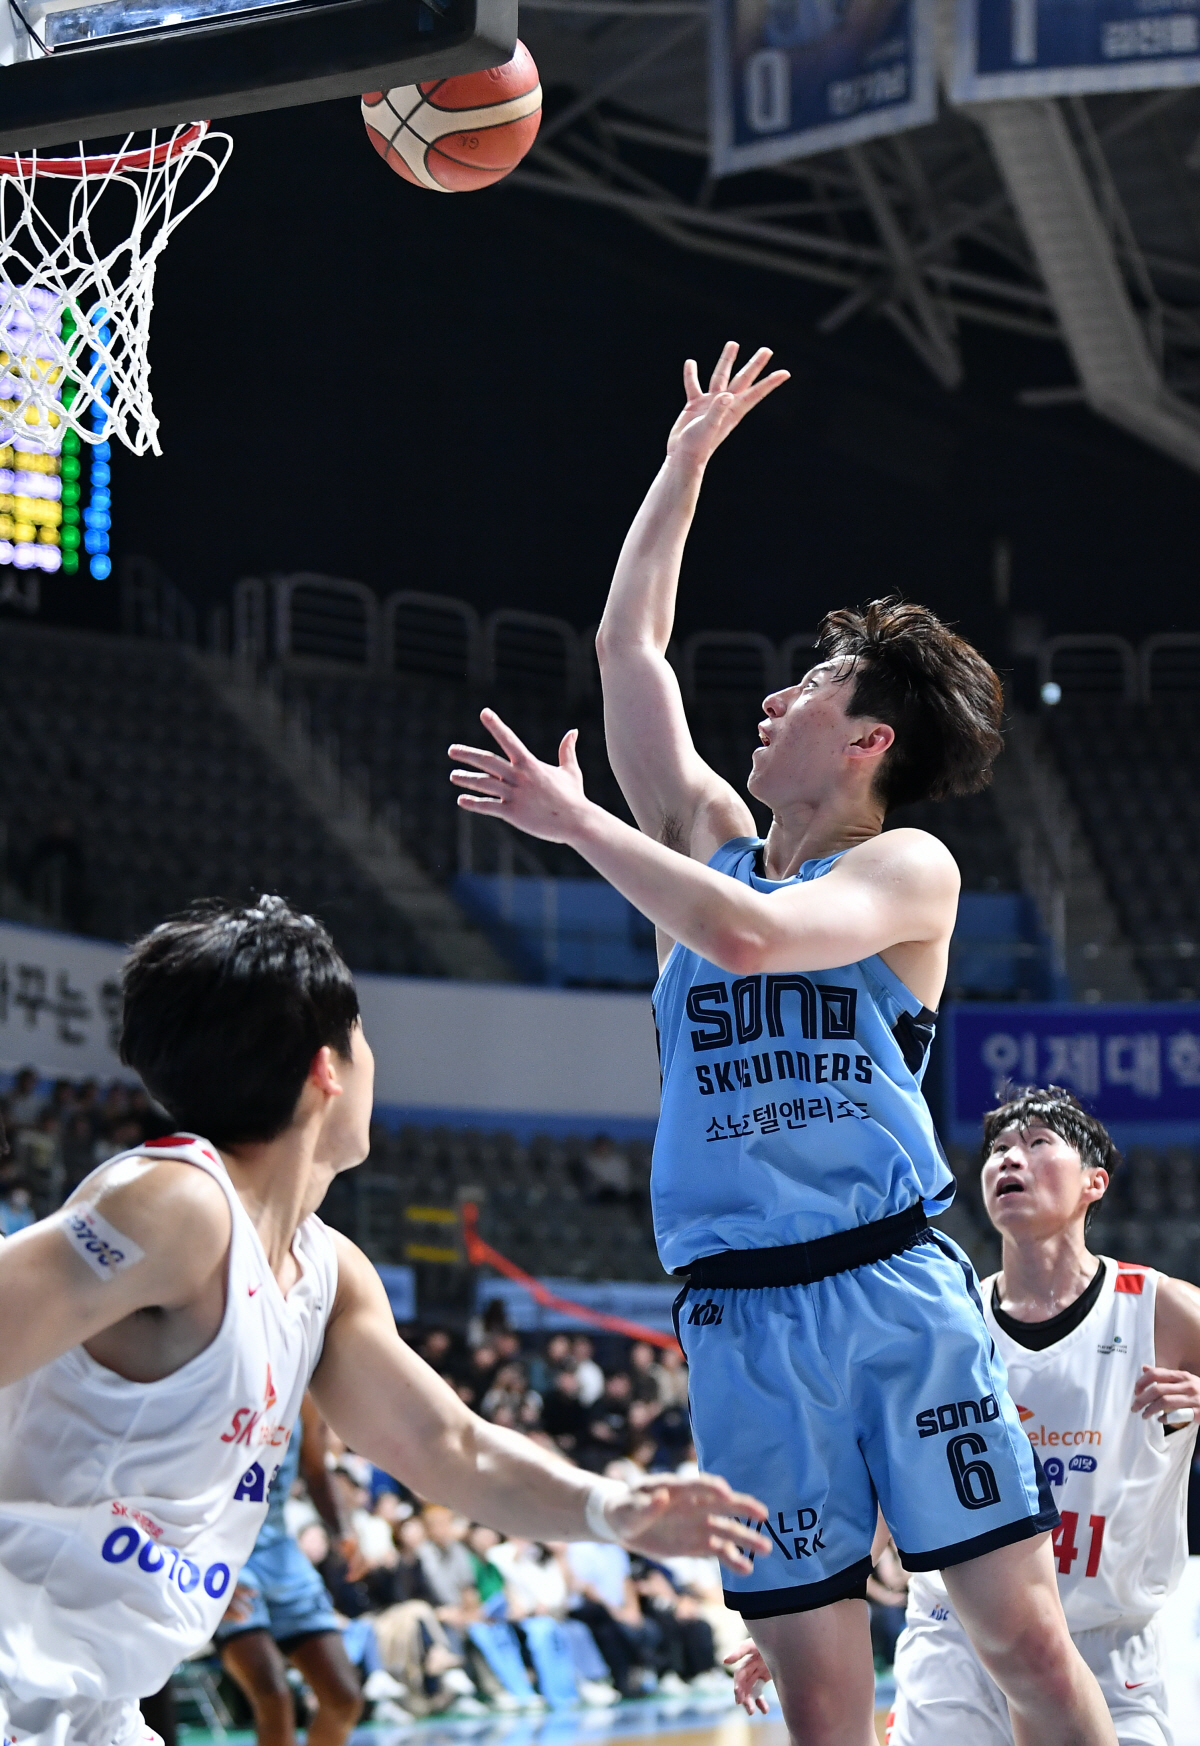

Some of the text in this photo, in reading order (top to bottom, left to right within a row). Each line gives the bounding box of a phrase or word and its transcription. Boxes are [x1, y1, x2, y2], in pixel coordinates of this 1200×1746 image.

[745, 50, 791, 133] 0
[687, 1299, 724, 1326] KBL
[1027, 1425, 1102, 1446] elecom
[946, 1432, 1001, 1510] 6
[1051, 1510, 1106, 1577] 41
